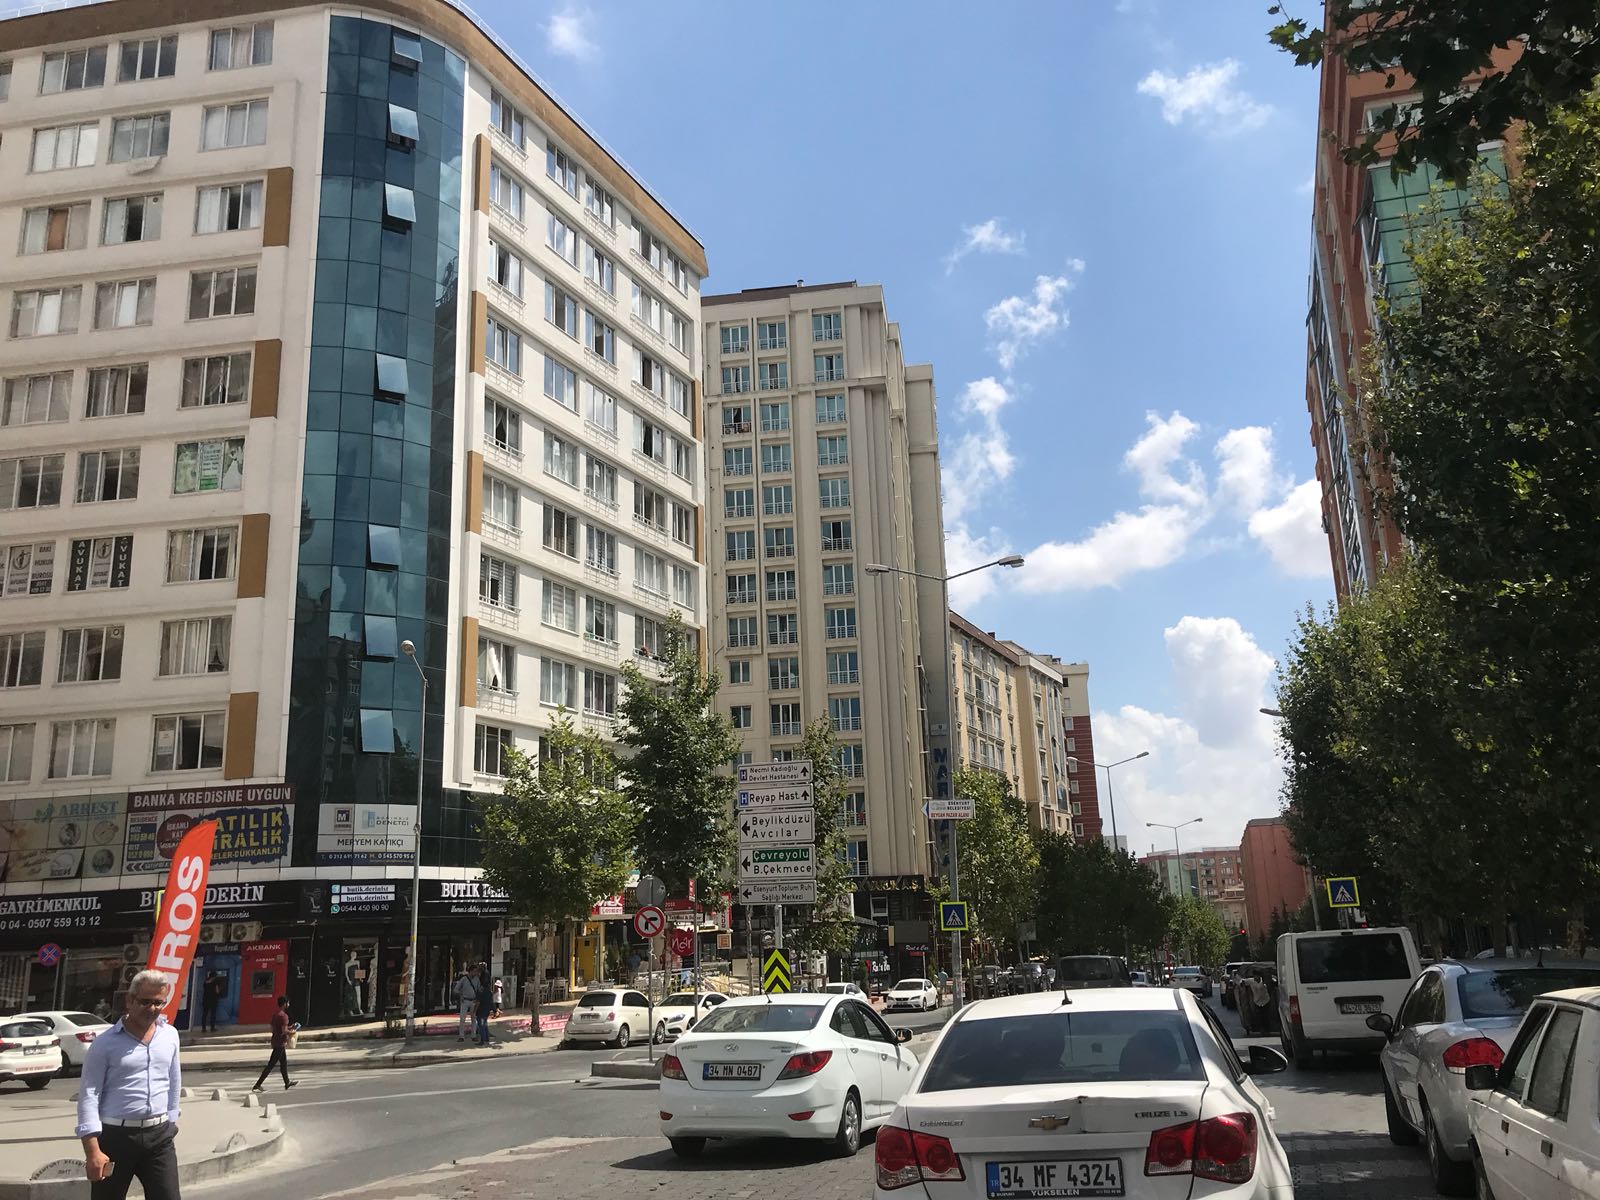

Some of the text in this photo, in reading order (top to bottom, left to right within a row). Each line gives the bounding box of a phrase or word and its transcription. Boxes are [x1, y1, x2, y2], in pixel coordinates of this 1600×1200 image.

[74, 541, 86, 590] AVUKAT
[117, 537, 128, 586] AVUKAT
[133, 793, 175, 808] BANKA
[247, 787, 291, 801] UYGUN
[749, 793, 776, 805] Reyap
[201, 811, 283, 833] ATILIK
[751, 814, 810, 827] Beylikdüzü
[751, 827, 799, 838] Avcılar
[373, 839, 404, 848] KAYIKÇI
[753, 848, 809, 861] Çevreyolu
[753, 864, 812, 876] B.Çekmece
[205, 883, 265, 904] DERİN
[440, 880, 480, 898] BUTİK
[753, 883, 812, 893] Esenyurt Toplum Ruh
[781, 892, 804, 900] Merkezi
[0, 897, 101, 915] GAYRİMENKUL
[381, 903, 390, 911] 90
[8, 920, 20, 929] 04
[27, 918, 51, 929] 0507
[53, 917, 71, 927] 559
[74, 917, 86, 926] 13
[89, 916, 101, 926] 12
[709, 1066, 719, 1076] 34
[722, 1065, 734, 1076] MN
[1001, 1163, 1116, 1188] 34 MF 4324
